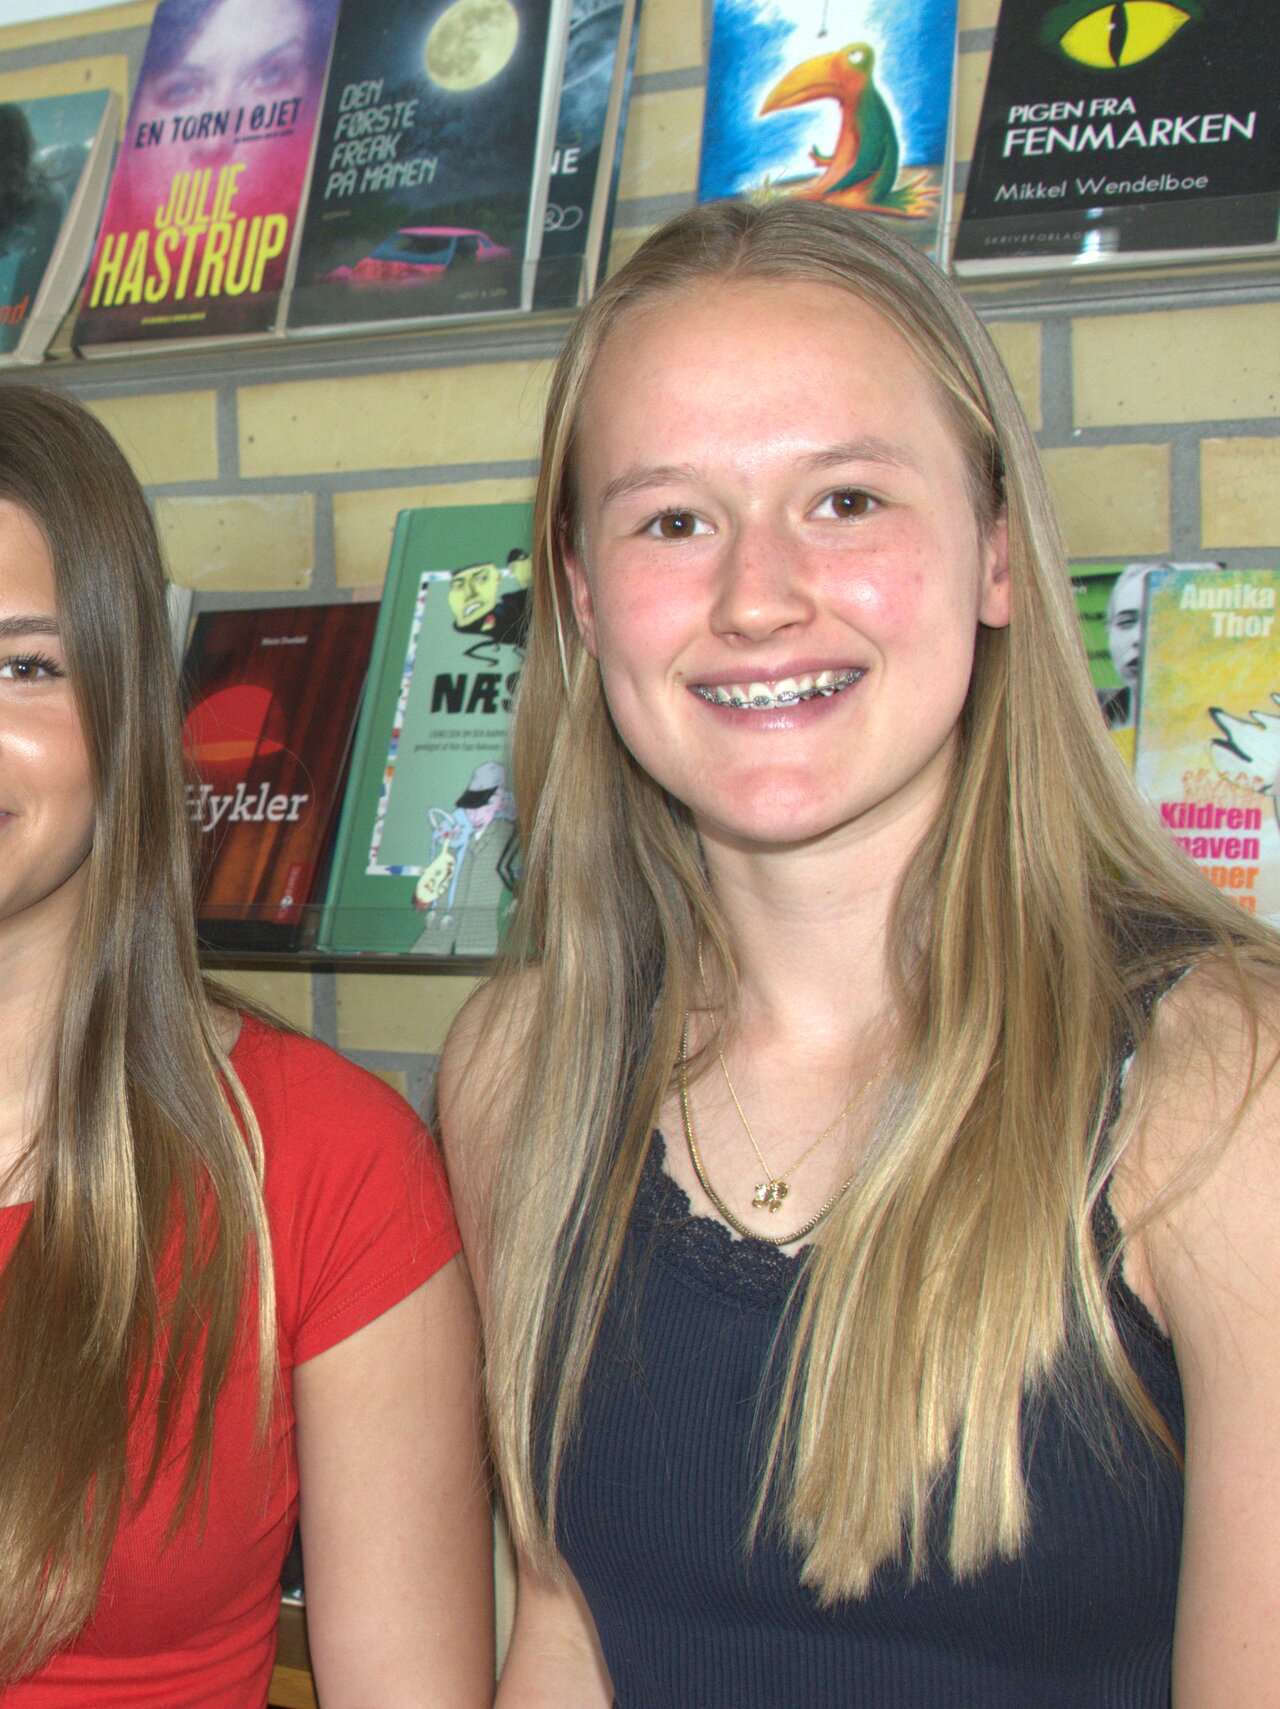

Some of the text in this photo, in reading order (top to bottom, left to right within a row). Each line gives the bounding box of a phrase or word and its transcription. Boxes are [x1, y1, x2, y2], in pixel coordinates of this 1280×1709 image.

[338, 78, 385, 113] DEN
[1008, 96, 1137, 125] PIGEN FRA
[135, 120, 164, 148] EN
[171, 108, 230, 143] TORN
[234, 106, 245, 133] I
[250, 97, 303, 131] ØJET
[333, 99, 420, 142] FØRSTE
[1002, 110, 1258, 158] FENMARKEN
[328, 132, 402, 170] FREAK
[154, 162, 248, 229] JULIE
[323, 167, 358, 200] PÅ
[994, 172, 1209, 202] Mikkel Wendelboe
[88, 212, 290, 309] HASTRUP
[1179, 583, 1277, 611] Annika
[1211, 611, 1275, 639] Thor
[184, 782, 309, 832] Hykler
